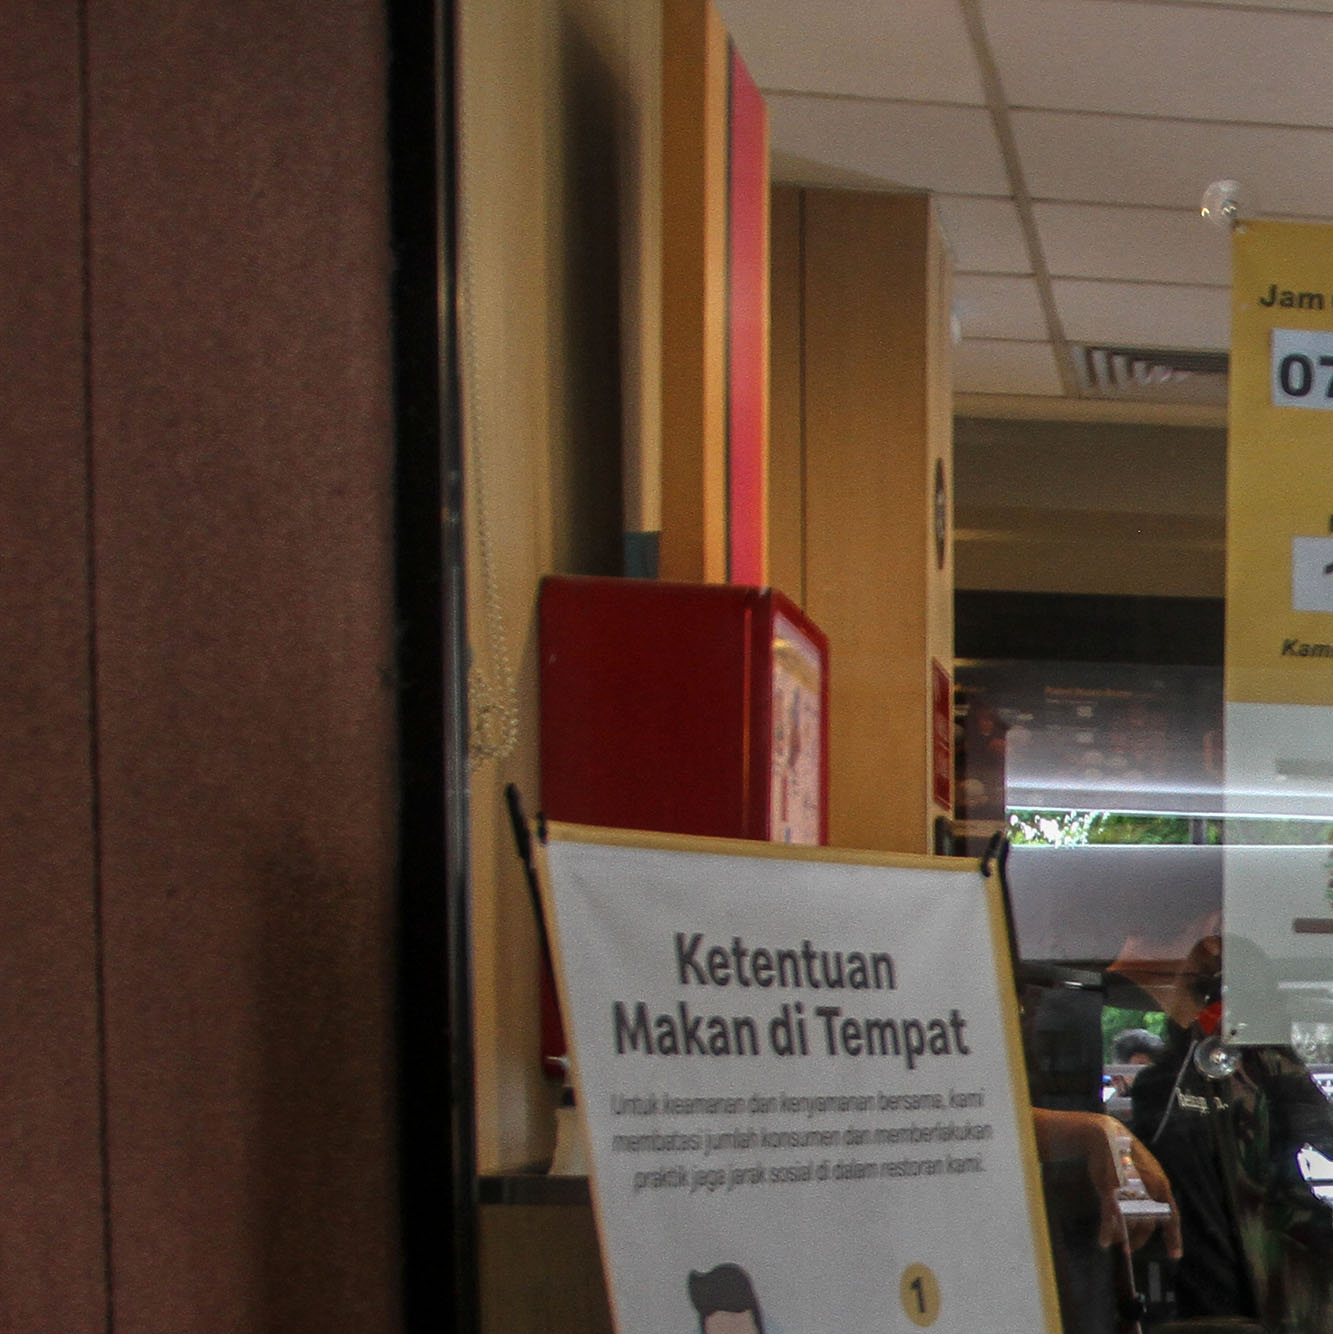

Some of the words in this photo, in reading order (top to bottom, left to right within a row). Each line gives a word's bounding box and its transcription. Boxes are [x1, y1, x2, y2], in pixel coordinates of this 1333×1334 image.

[1260, 284, 1324, 310] Jam
[674, 932, 898, 990] Ketentuan
[612, 1000, 760, 1056] Makan
[769, 1000, 811, 1056] di
[815, 1006, 972, 1070] Tempat
[611, 1093, 657, 1115] Untuk
[663, 1092, 747, 1115] keamanan
[749, 1092, 777, 1114] dan
[780, 1091, 875, 1118] kenyamanan
[949, 1087, 985, 1109] kami
[612, 1129, 701, 1151] membatasi
[704, 1127, 758, 1157] jumlah
[760, 1127, 841, 1148] konsumen
[844, 1125, 872, 1146] dan
[633, 1165, 688, 1193] praktik
[689, 1165, 727, 1193] jaga
[727, 1162, 765, 1191] jarak
[770, 1160, 815, 1182] sosial
[816, 1160, 831, 1181] di
[832, 1159, 879, 1180] dalam
[881, 1160, 945, 1178] restoran
[910, 1276, 926, 1313] 1
